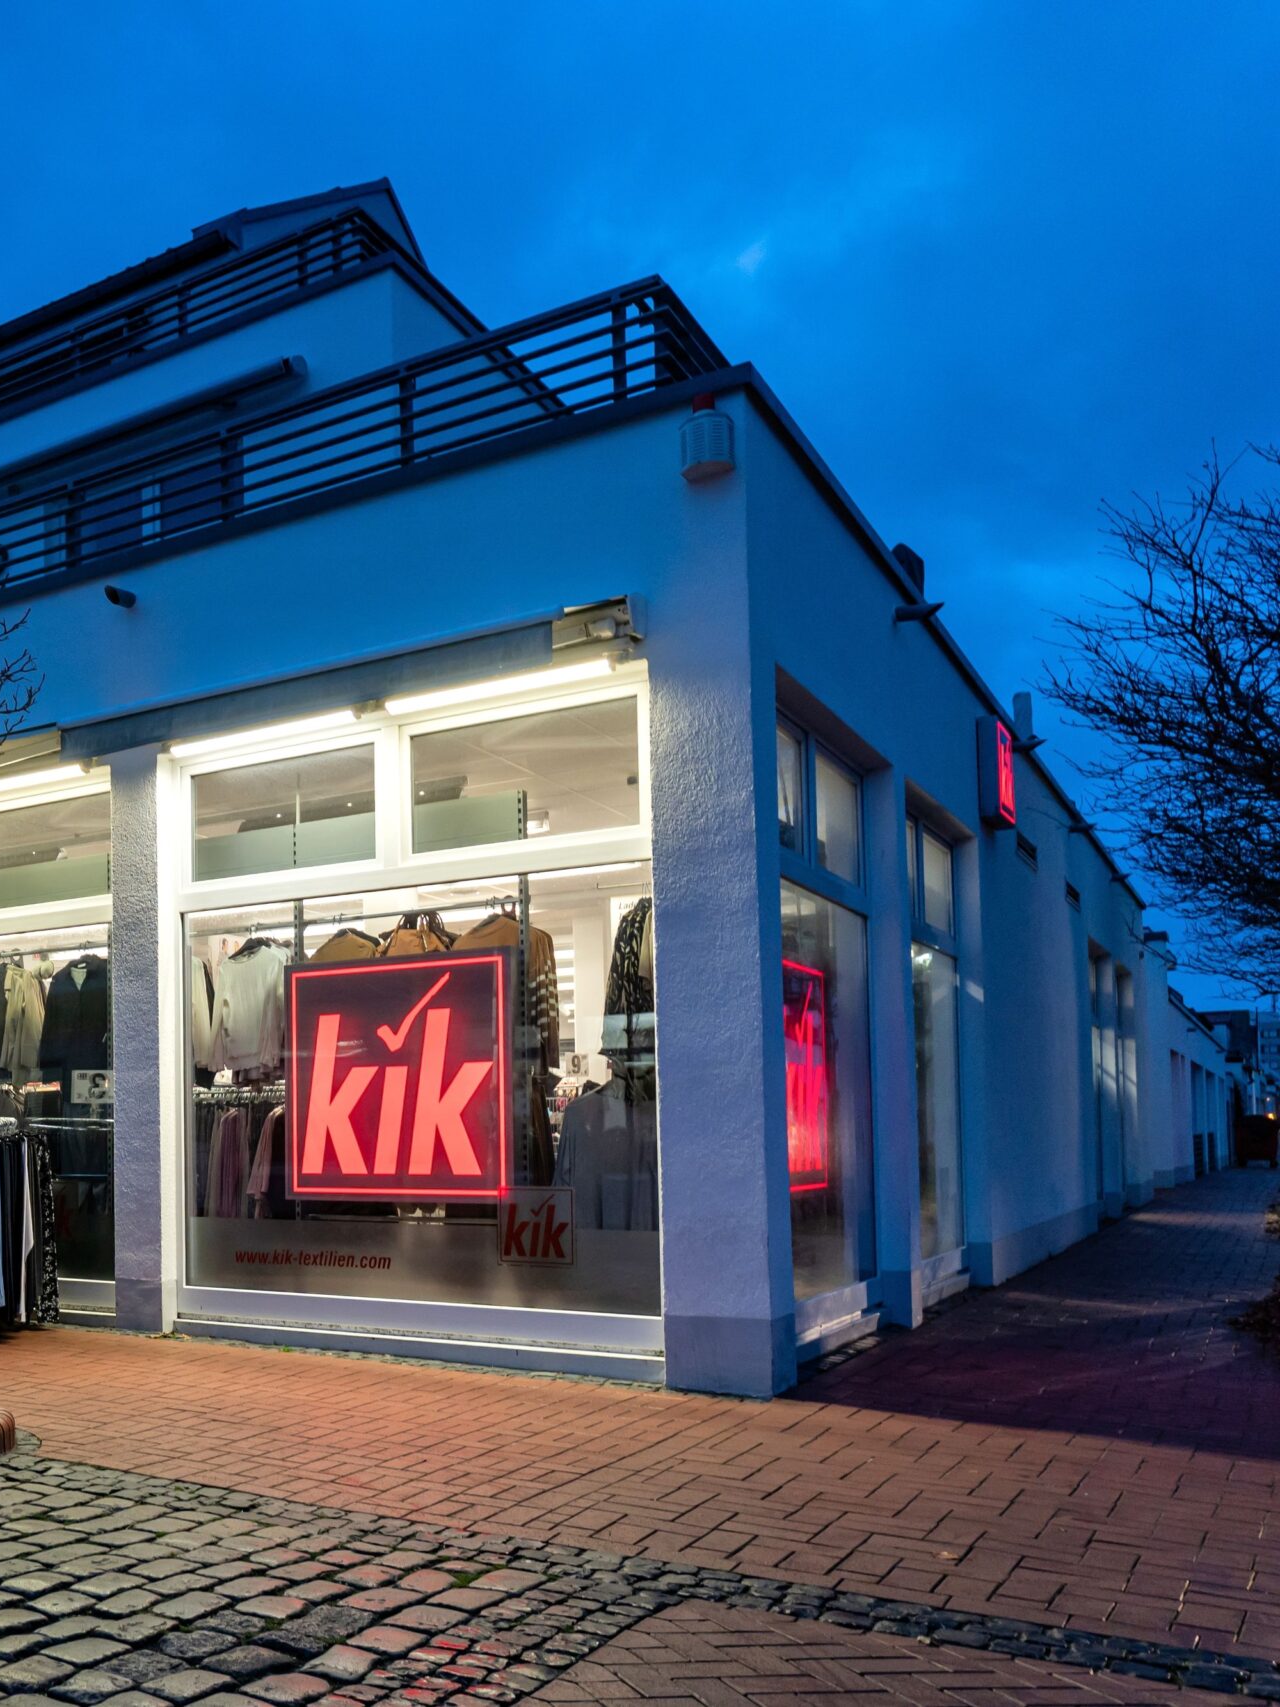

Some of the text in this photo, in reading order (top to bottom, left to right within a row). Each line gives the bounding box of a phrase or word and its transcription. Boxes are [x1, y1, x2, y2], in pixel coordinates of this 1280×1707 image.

[301, 971, 494, 1176] kik
[571, 1055, 581, 1074] 9
[503, 1193, 569, 1259] kik
[235, 1249, 392, 1269] www.kik-textilien.com
